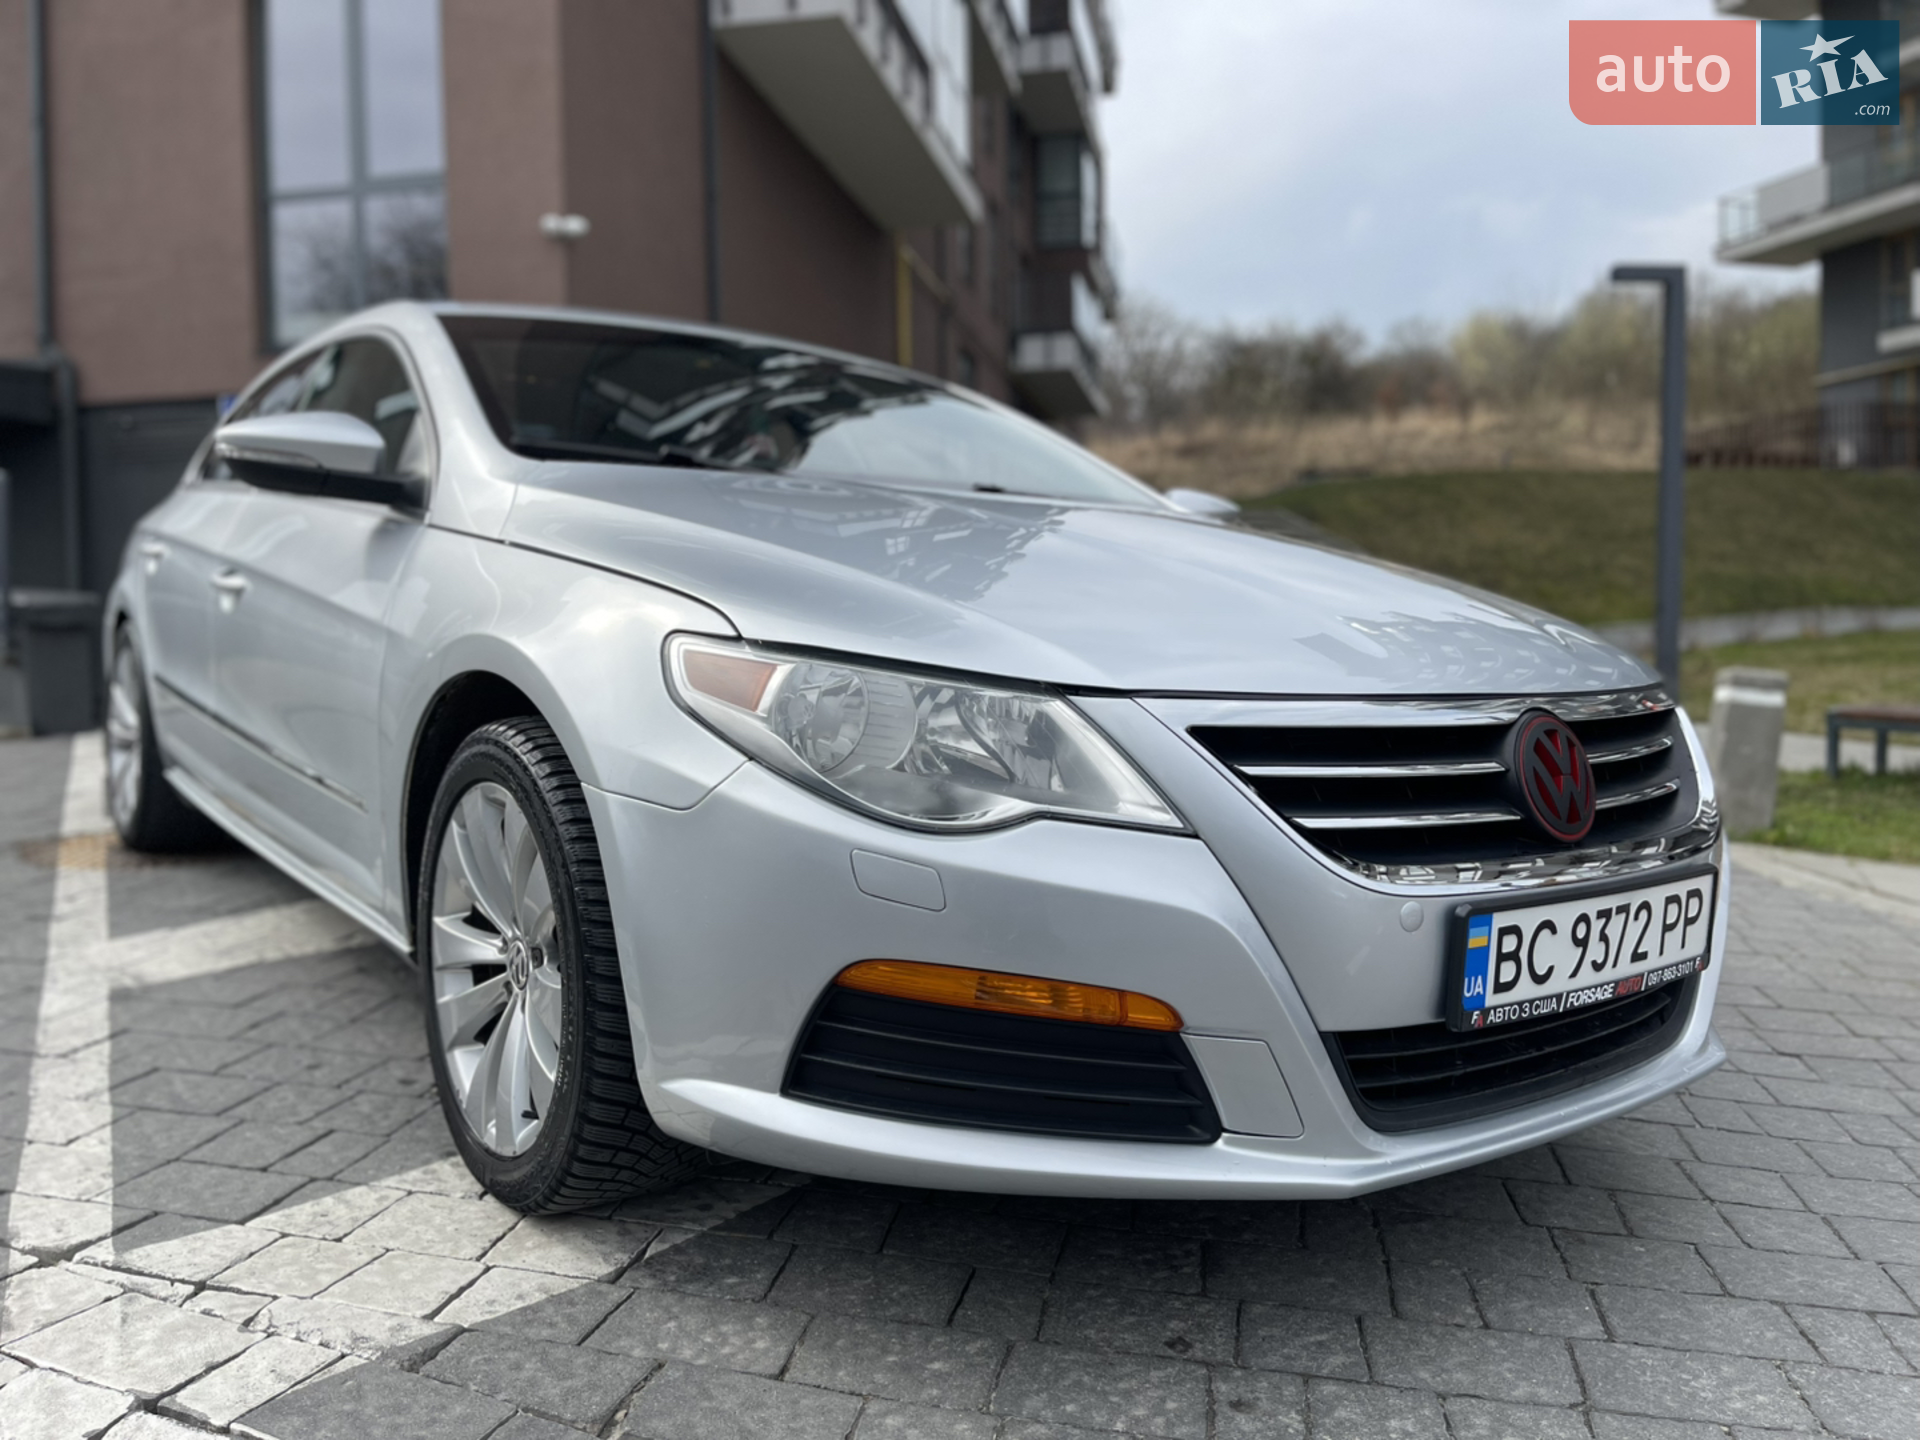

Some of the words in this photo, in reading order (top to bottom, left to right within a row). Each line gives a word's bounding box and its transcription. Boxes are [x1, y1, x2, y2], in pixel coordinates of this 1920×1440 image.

[1493, 919, 1558, 994] BC
[1568, 900, 1653, 979] 9372
[1659, 888, 1703, 956] PP
[1464, 975, 1483, 997] UA
[1487, 1004, 1519, 1024] АВТО
[1532, 997, 1557, 1015] США
[1566, 983, 1615, 1008] FORSAGE
[1615, 975, 1643, 996] AUTO
